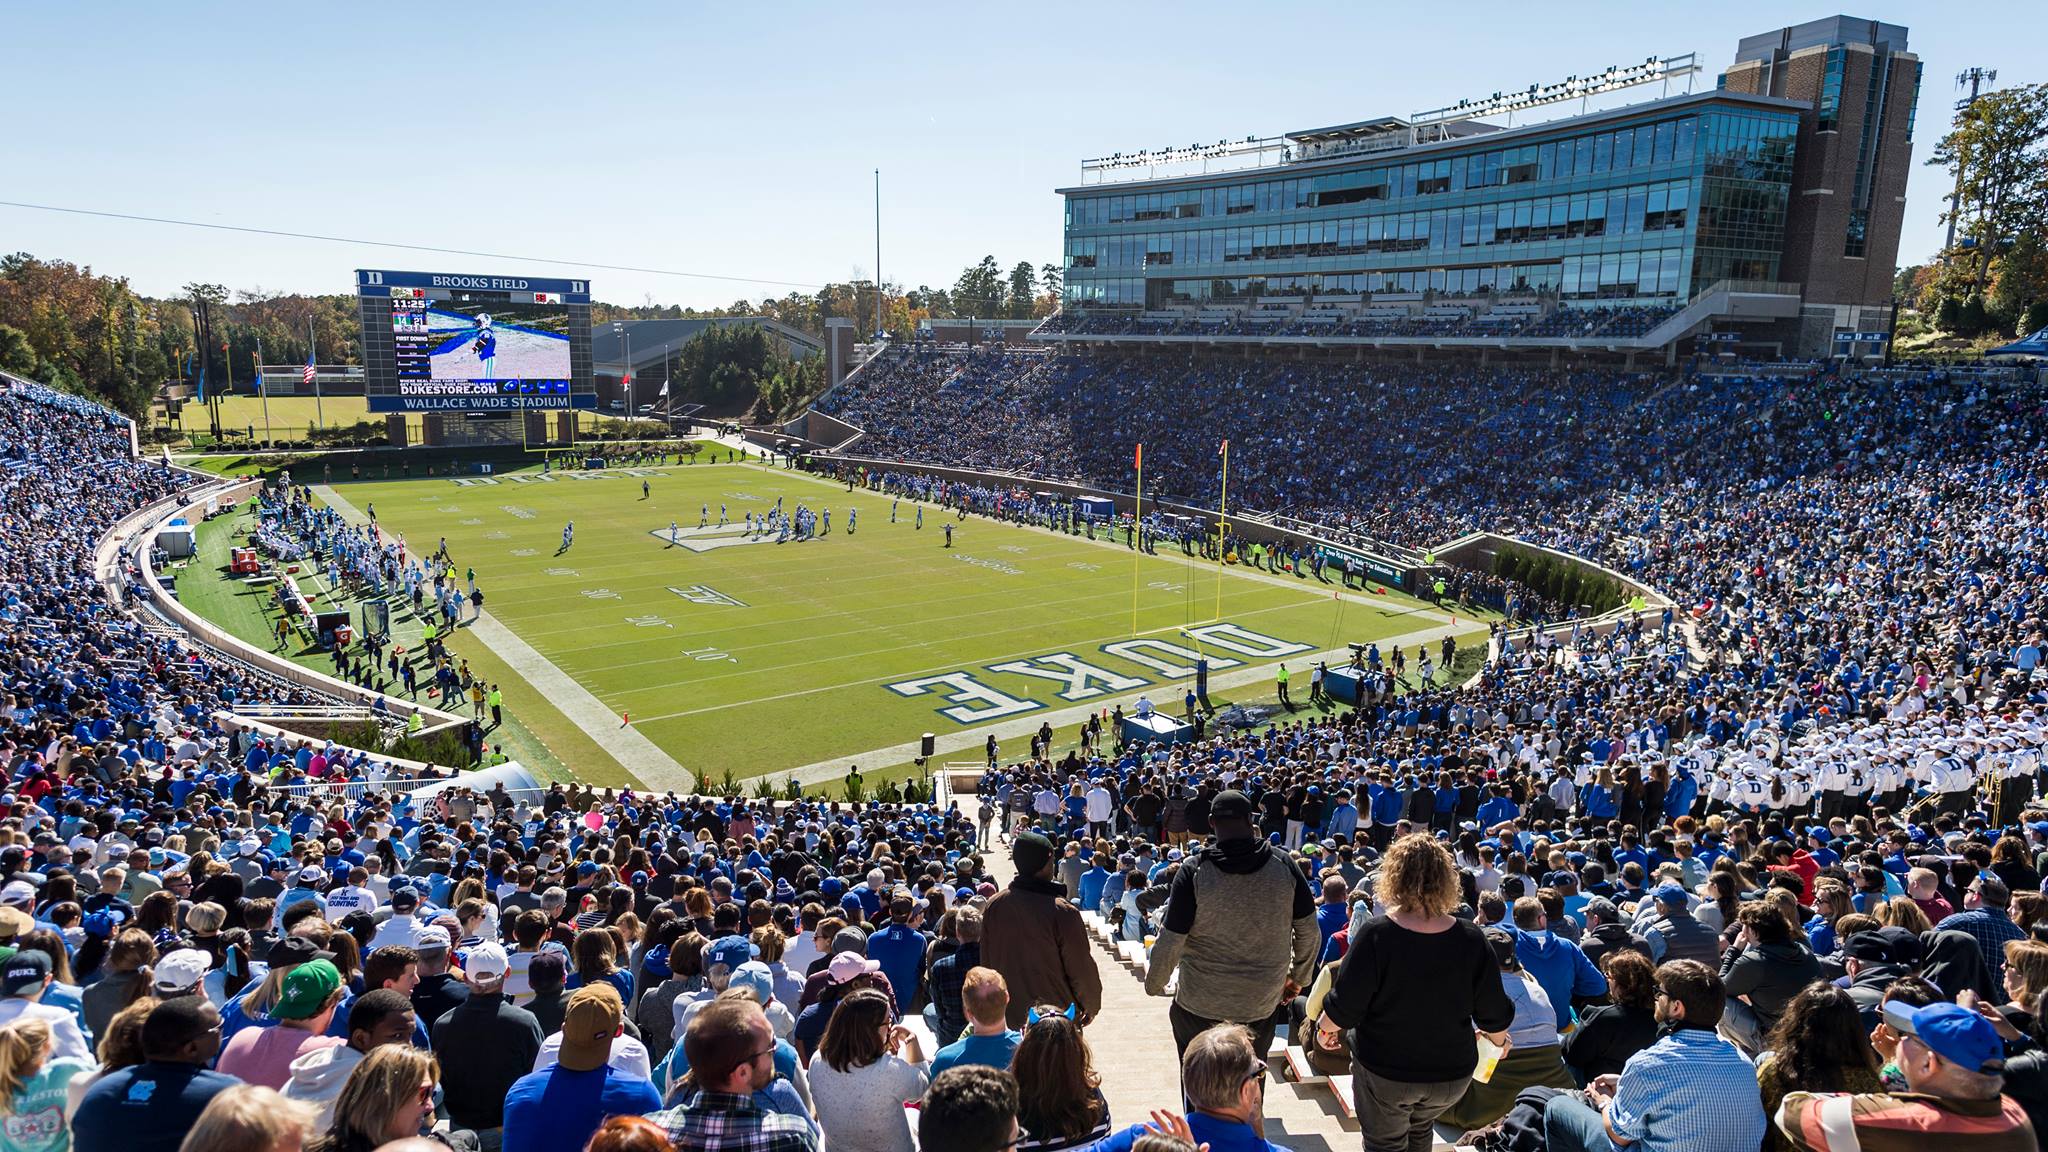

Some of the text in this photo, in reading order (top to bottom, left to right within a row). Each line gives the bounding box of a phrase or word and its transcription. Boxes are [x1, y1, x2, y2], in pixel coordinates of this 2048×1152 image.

[367, 272, 383, 285] D
[432, 275, 529, 290] BROOKS FIELD
[571, 281, 585, 293] D
[393, 299, 426, 309] 11:25
[413, 317, 423, 326] 21
[401, 385, 498, 395] DUKESTORE.COM
[404, 397, 569, 409] WALLACE WADE STADIUM
[881, 623, 1320, 725] DUKE
[1689, 760, 1700, 770] D
[1836, 763, 1848, 775] D
[1943, 758, 1962, 772] D
[1704, 774, 1713, 783] D
[1750, 782, 1762, 793] D
[1801, 782, 1810, 793] D
[8, 967, 38, 978] DUKE
